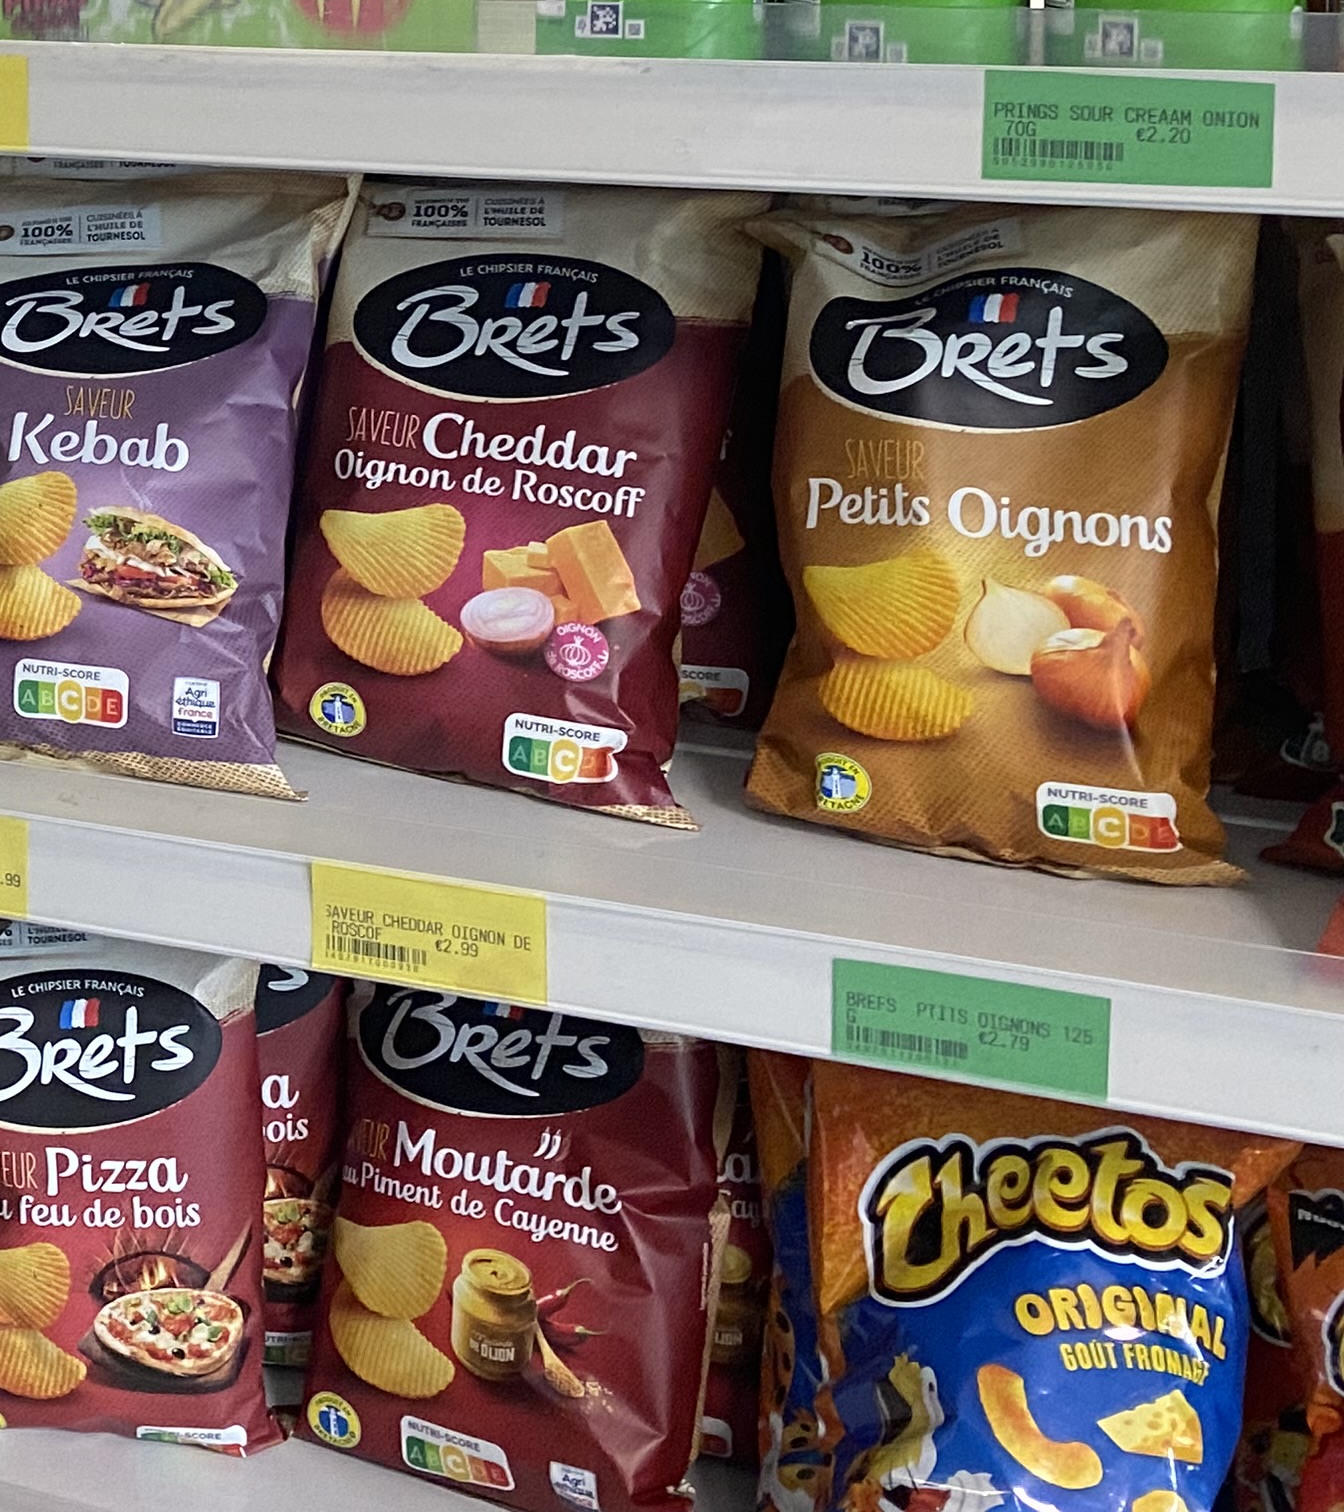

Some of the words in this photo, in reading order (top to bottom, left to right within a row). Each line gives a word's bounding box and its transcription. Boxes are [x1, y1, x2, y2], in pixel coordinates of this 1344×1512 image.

[993, 102, 1059, 121] PRINGS
[1070, 105, 1113, 122] SOUR
[1124, 107, 1192, 126] CREAAM
[1203, 110, 1260, 129] ONION
[1005, 121, 1037, 137] 70G
[1136, 127, 1192, 145] €2.20
[413, 202, 469, 220] 100%
[483, 215, 547, 228] TOURNESOL
[20, 223, 74, 240] 100%
[85, 228, 146, 243] TOURNESOL
[460, 266, 475, 278] LE
[477, 263, 534, 275] CHIPSIER
[537, 264, 599, 284] FRANÇAIS
[0, 287, 237, 353] Brets
[391, 285, 641, 377] Brets
[845, 305, 1129, 406] Brets
[64, 386, 134, 421] SAVEUR
[7, 412, 191, 472] Kebab
[346, 406, 421, 450] SAVEUR
[421, 411, 638, 479] Cheddar
[845, 438, 926, 481] SAVEUR
[334, 447, 456, 492] Oignon
[462, 467, 504, 498] de
[511, 469, 647, 518] Roscoff
[805, 477, 931, 530] Petits
[947, 486, 1173, 558] Oignons
[23, 662, 101, 682] NUTRI-SCORE
[177, 706, 213, 720] france
[514, 719, 601, 743] NUTRI-SCORE
[1046, 786, 1149, 810] NUTRI-SCORE
[326, 904, 374, 925] SAVEUR
[382, 913, 444, 936] CHEDDAR
[452, 924, 505, 947] OIGNON
[513, 935, 532, 952] DE
[332, 919, 383, 940] ROSCOF
[435, 939, 479, 958] €2.99
[11, 984, 26, 999] LE
[29, 980, 82, 996] CHIPSIER
[85, 978, 145, 998] FRANÇAIS
[977, 1012, 1052, 1040] OIGNONS
[1063, 1024, 1095, 1046] 125
[978, 1030, 1031, 1052] €2.79
[44, 1146, 189, 1195] Pizza
[393, 1120, 623, 1215] Moutarde
[18, 1195, 78, 1229] feu
[83, 1199, 125, 1230] de
[132, 1196, 201, 1229] bois
[360, 1167, 443, 1211] Piment
[450, 1194, 486, 1221] de
[494, 1198, 619, 1253] Cayenne
[872, 1142, 1234, 1294] Cheetos
[1014, 1284, 1227, 1360] ORIGINAL
